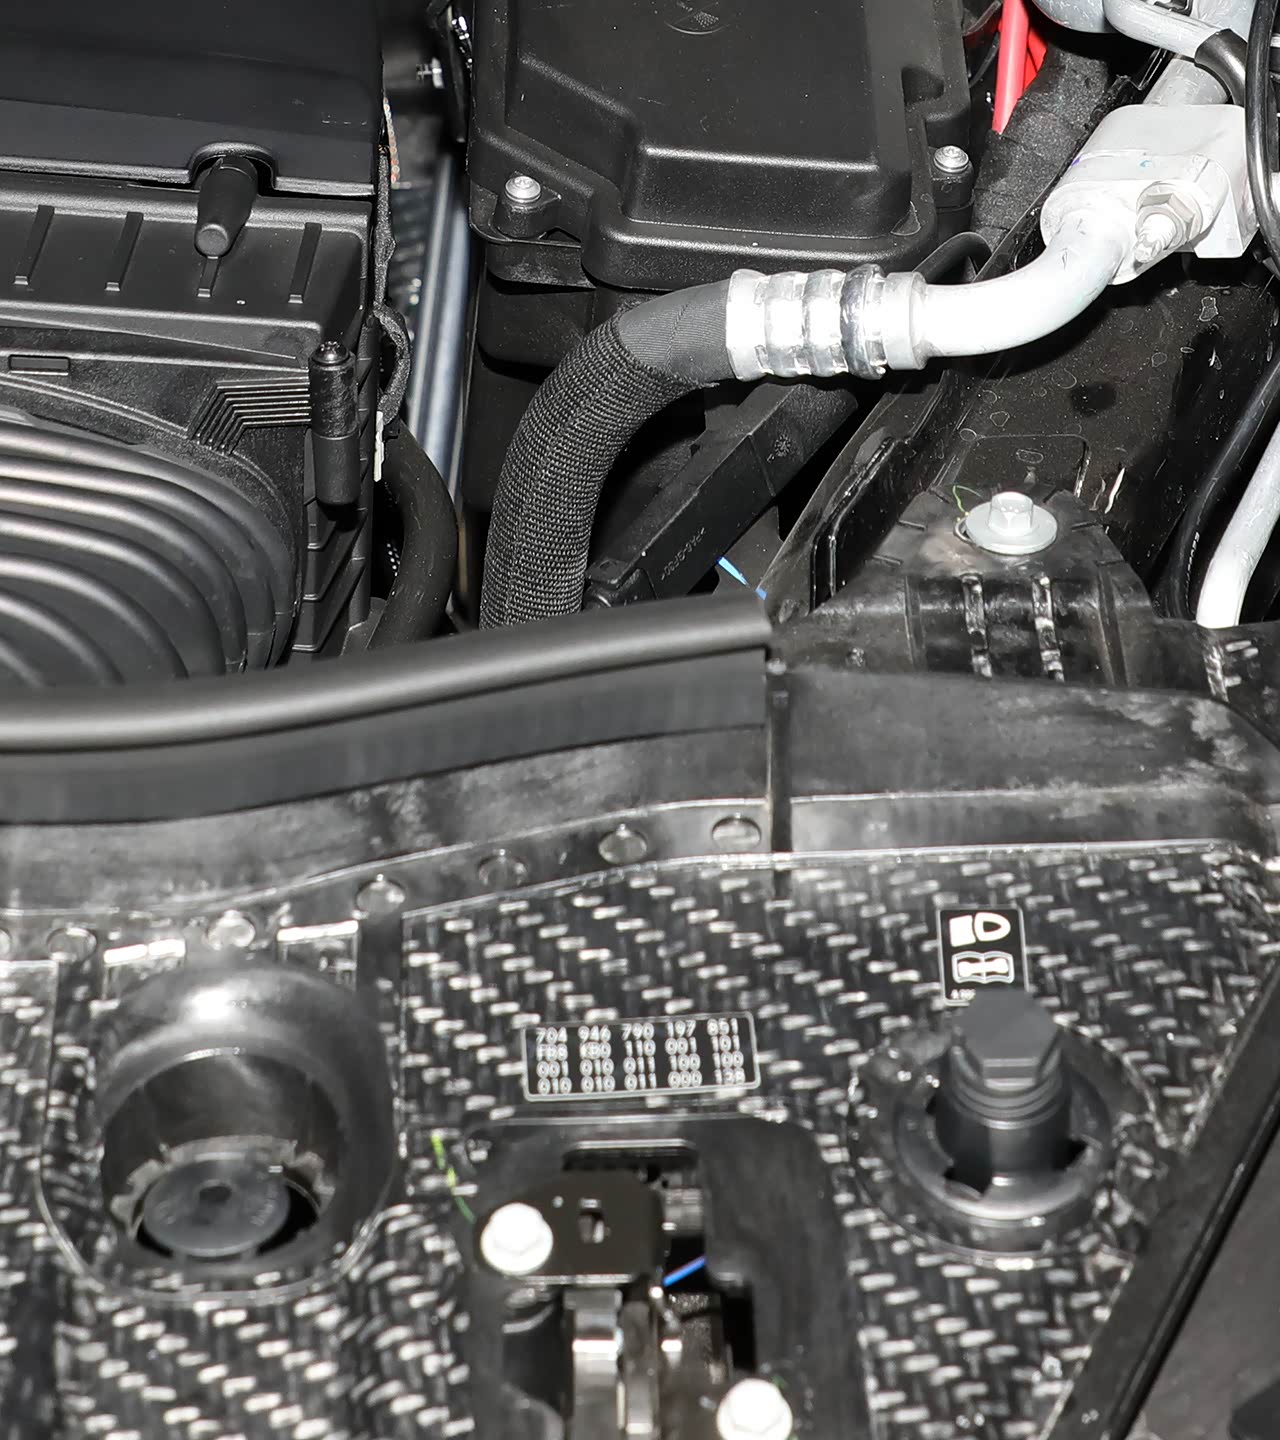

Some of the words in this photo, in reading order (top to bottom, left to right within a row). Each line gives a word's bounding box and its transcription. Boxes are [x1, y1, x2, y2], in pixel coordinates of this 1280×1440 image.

[667, 1020, 697, 1038] 197
[624, 1039, 657, 1057] 110
[665, 1037, 698, 1055] 001
[712, 1034, 740, 1053] 101
[536, 1060, 569, 1078] 001
[579, 1058, 615, 1077] 010
[623, 1056, 656, 1075] 011
[669, 1053, 701, 1072] 100
[712, 1050, 744, 1069] 100
[537, 1077, 573, 1095] 010
[580, 1075, 616, 1093] 010
[624, 1072, 657, 1091] 011
